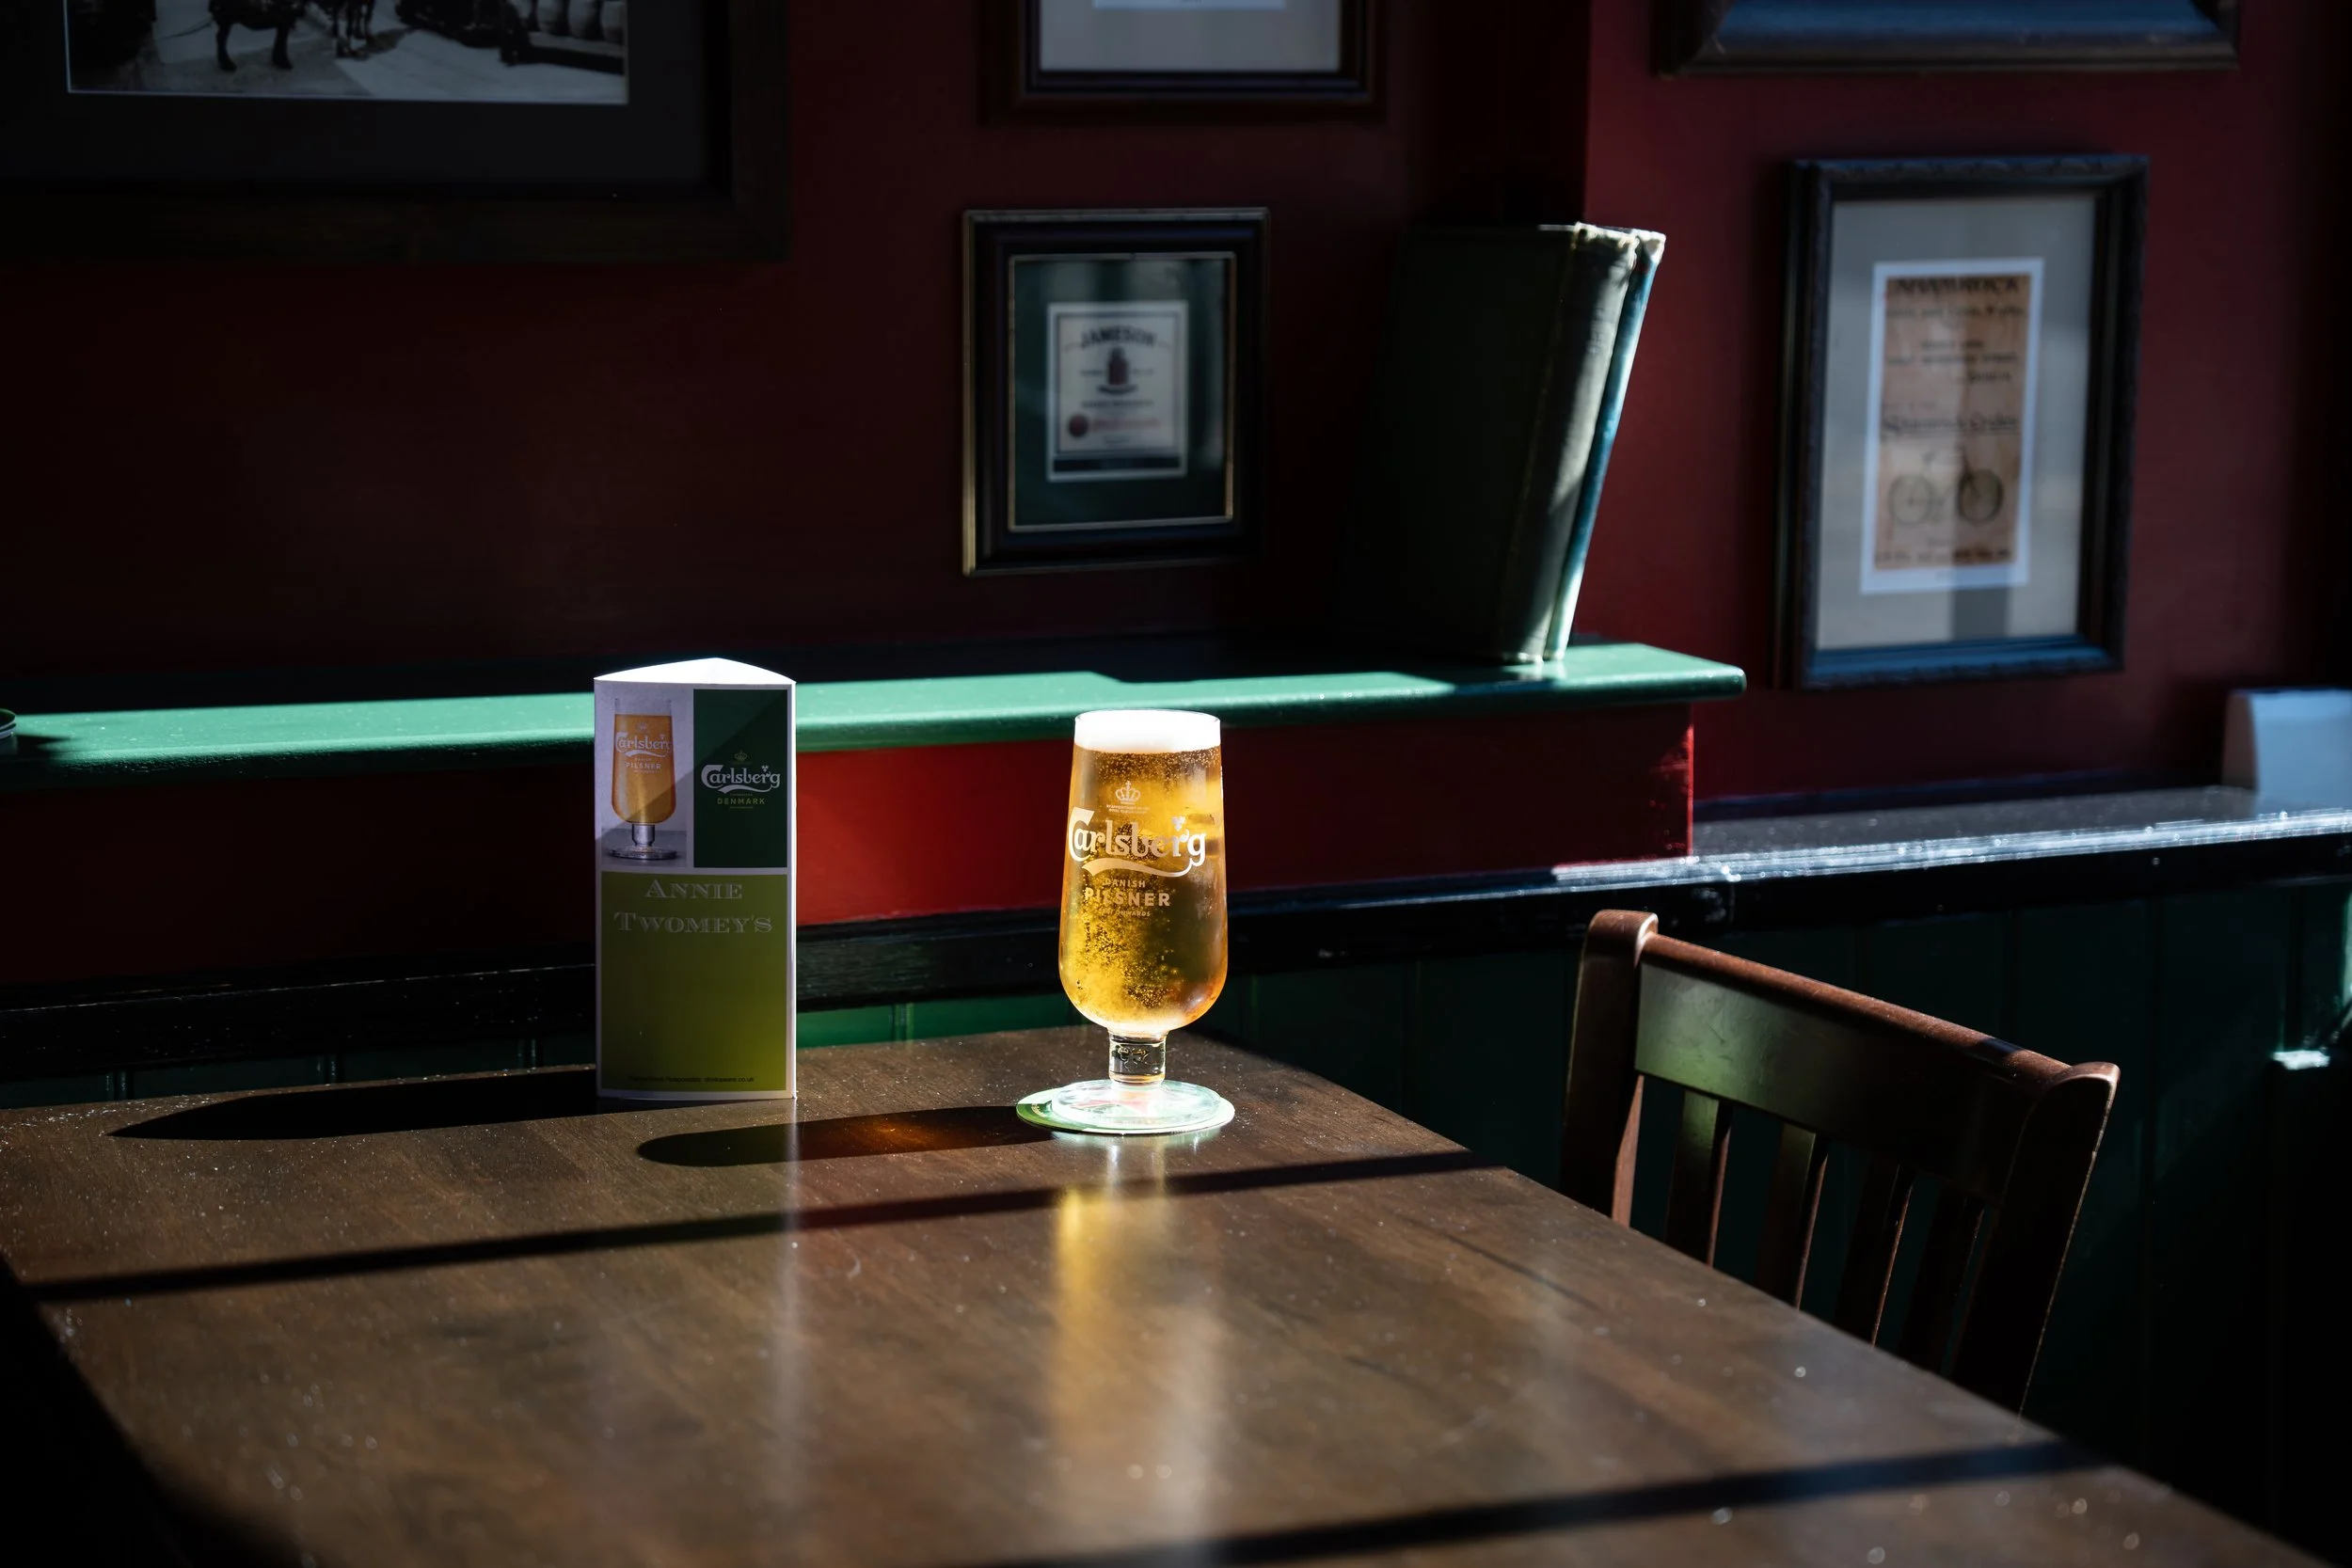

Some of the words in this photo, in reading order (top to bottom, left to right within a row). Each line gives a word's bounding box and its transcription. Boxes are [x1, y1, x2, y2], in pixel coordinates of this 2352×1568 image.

[701, 765, 782, 789] Carlsberg
[1069, 806, 1207, 868] Carlsberg
[644, 879, 743, 900] ANNIE
[1104, 878, 1146, 889] DANISH
[1084, 887, 1170, 907] PILSNER
[613, 911, 773, 934] TWOMEY'S
